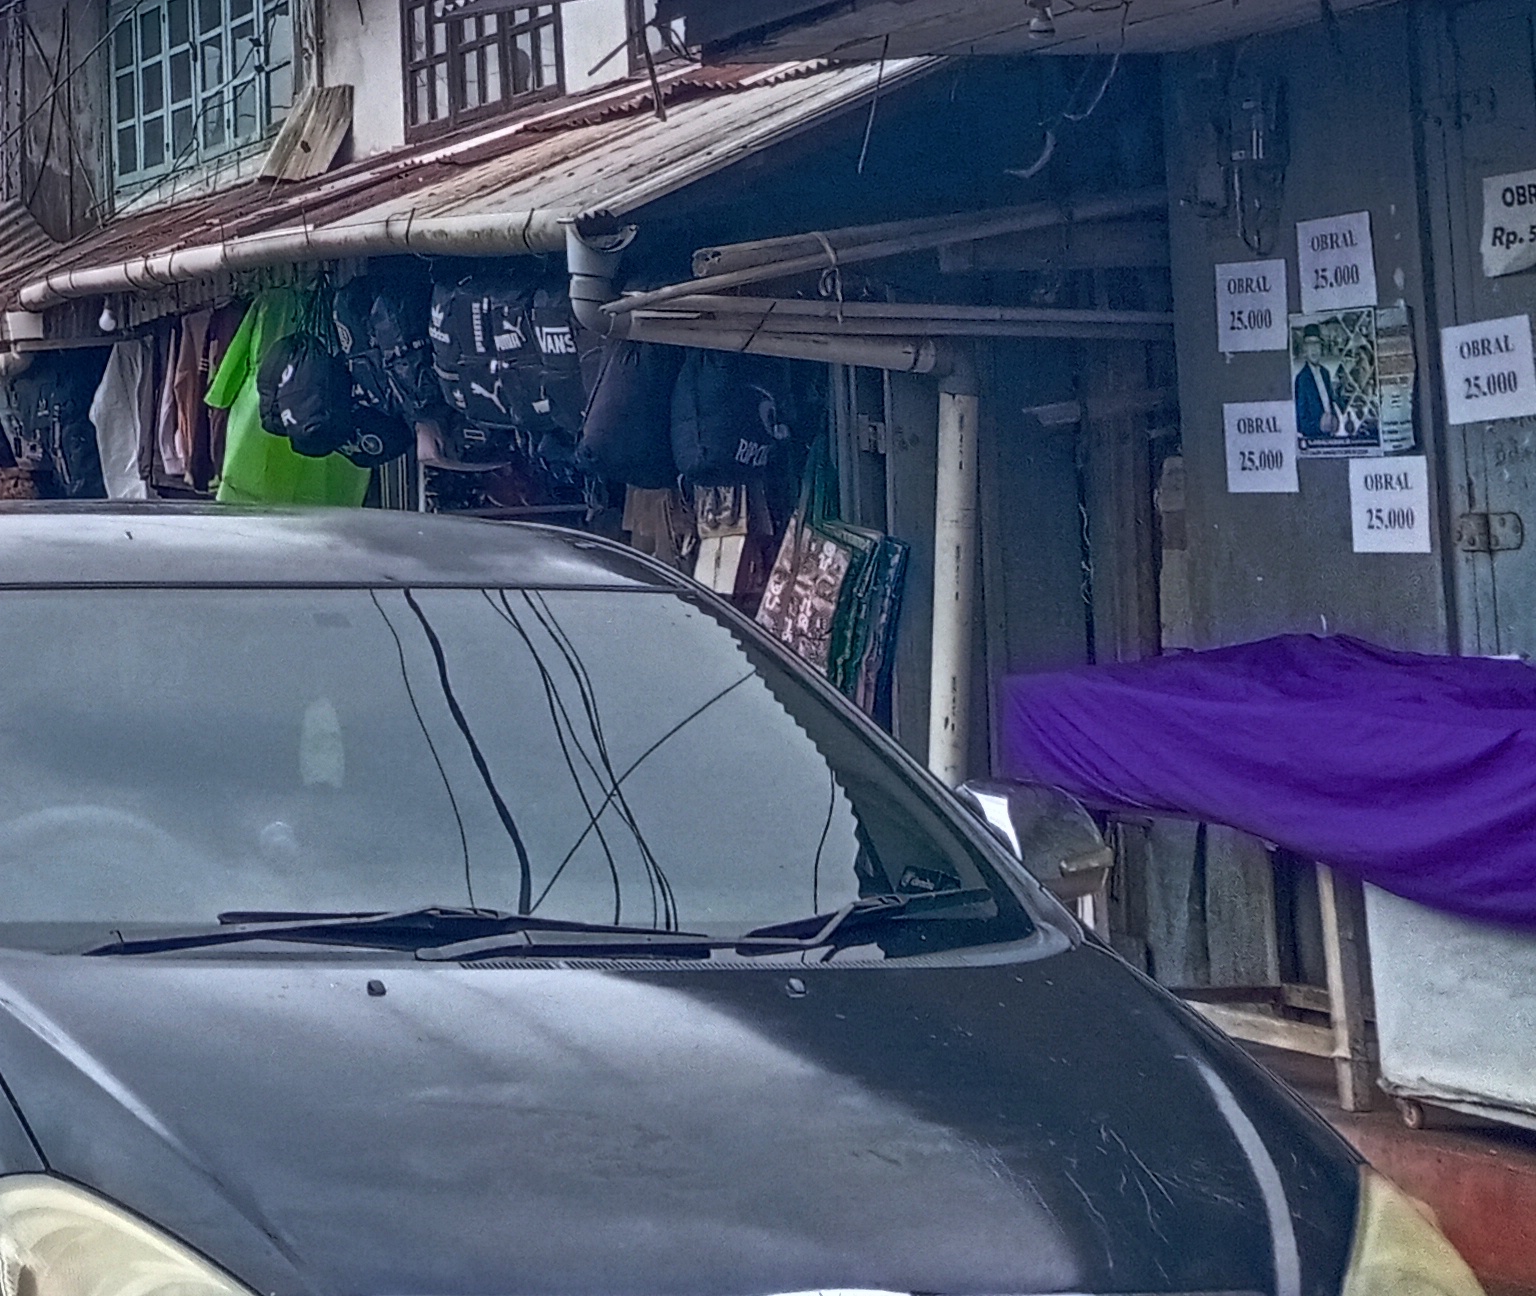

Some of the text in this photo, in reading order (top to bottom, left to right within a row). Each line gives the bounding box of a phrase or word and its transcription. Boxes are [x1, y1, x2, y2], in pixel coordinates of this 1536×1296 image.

[1311, 230, 1358, 252] OBRAL
[1491, 226, 1524, 249] Rp.
[1228, 276, 1271, 294] OBRAL
[1313, 264, 1360, 290] 25.000
[1230, 309, 1272, 330] 25.000
[535, 326, 576, 353] VANS
[1459, 335, 1515, 358] OBRAL
[1465, 371, 1518, 399] 25.000
[1237, 416, 1282, 434] OBRAL
[1240, 451, 1284, 471] 25.000
[1364, 472, 1413, 491] OBRAL
[1366, 508, 1415, 529] 25.000
